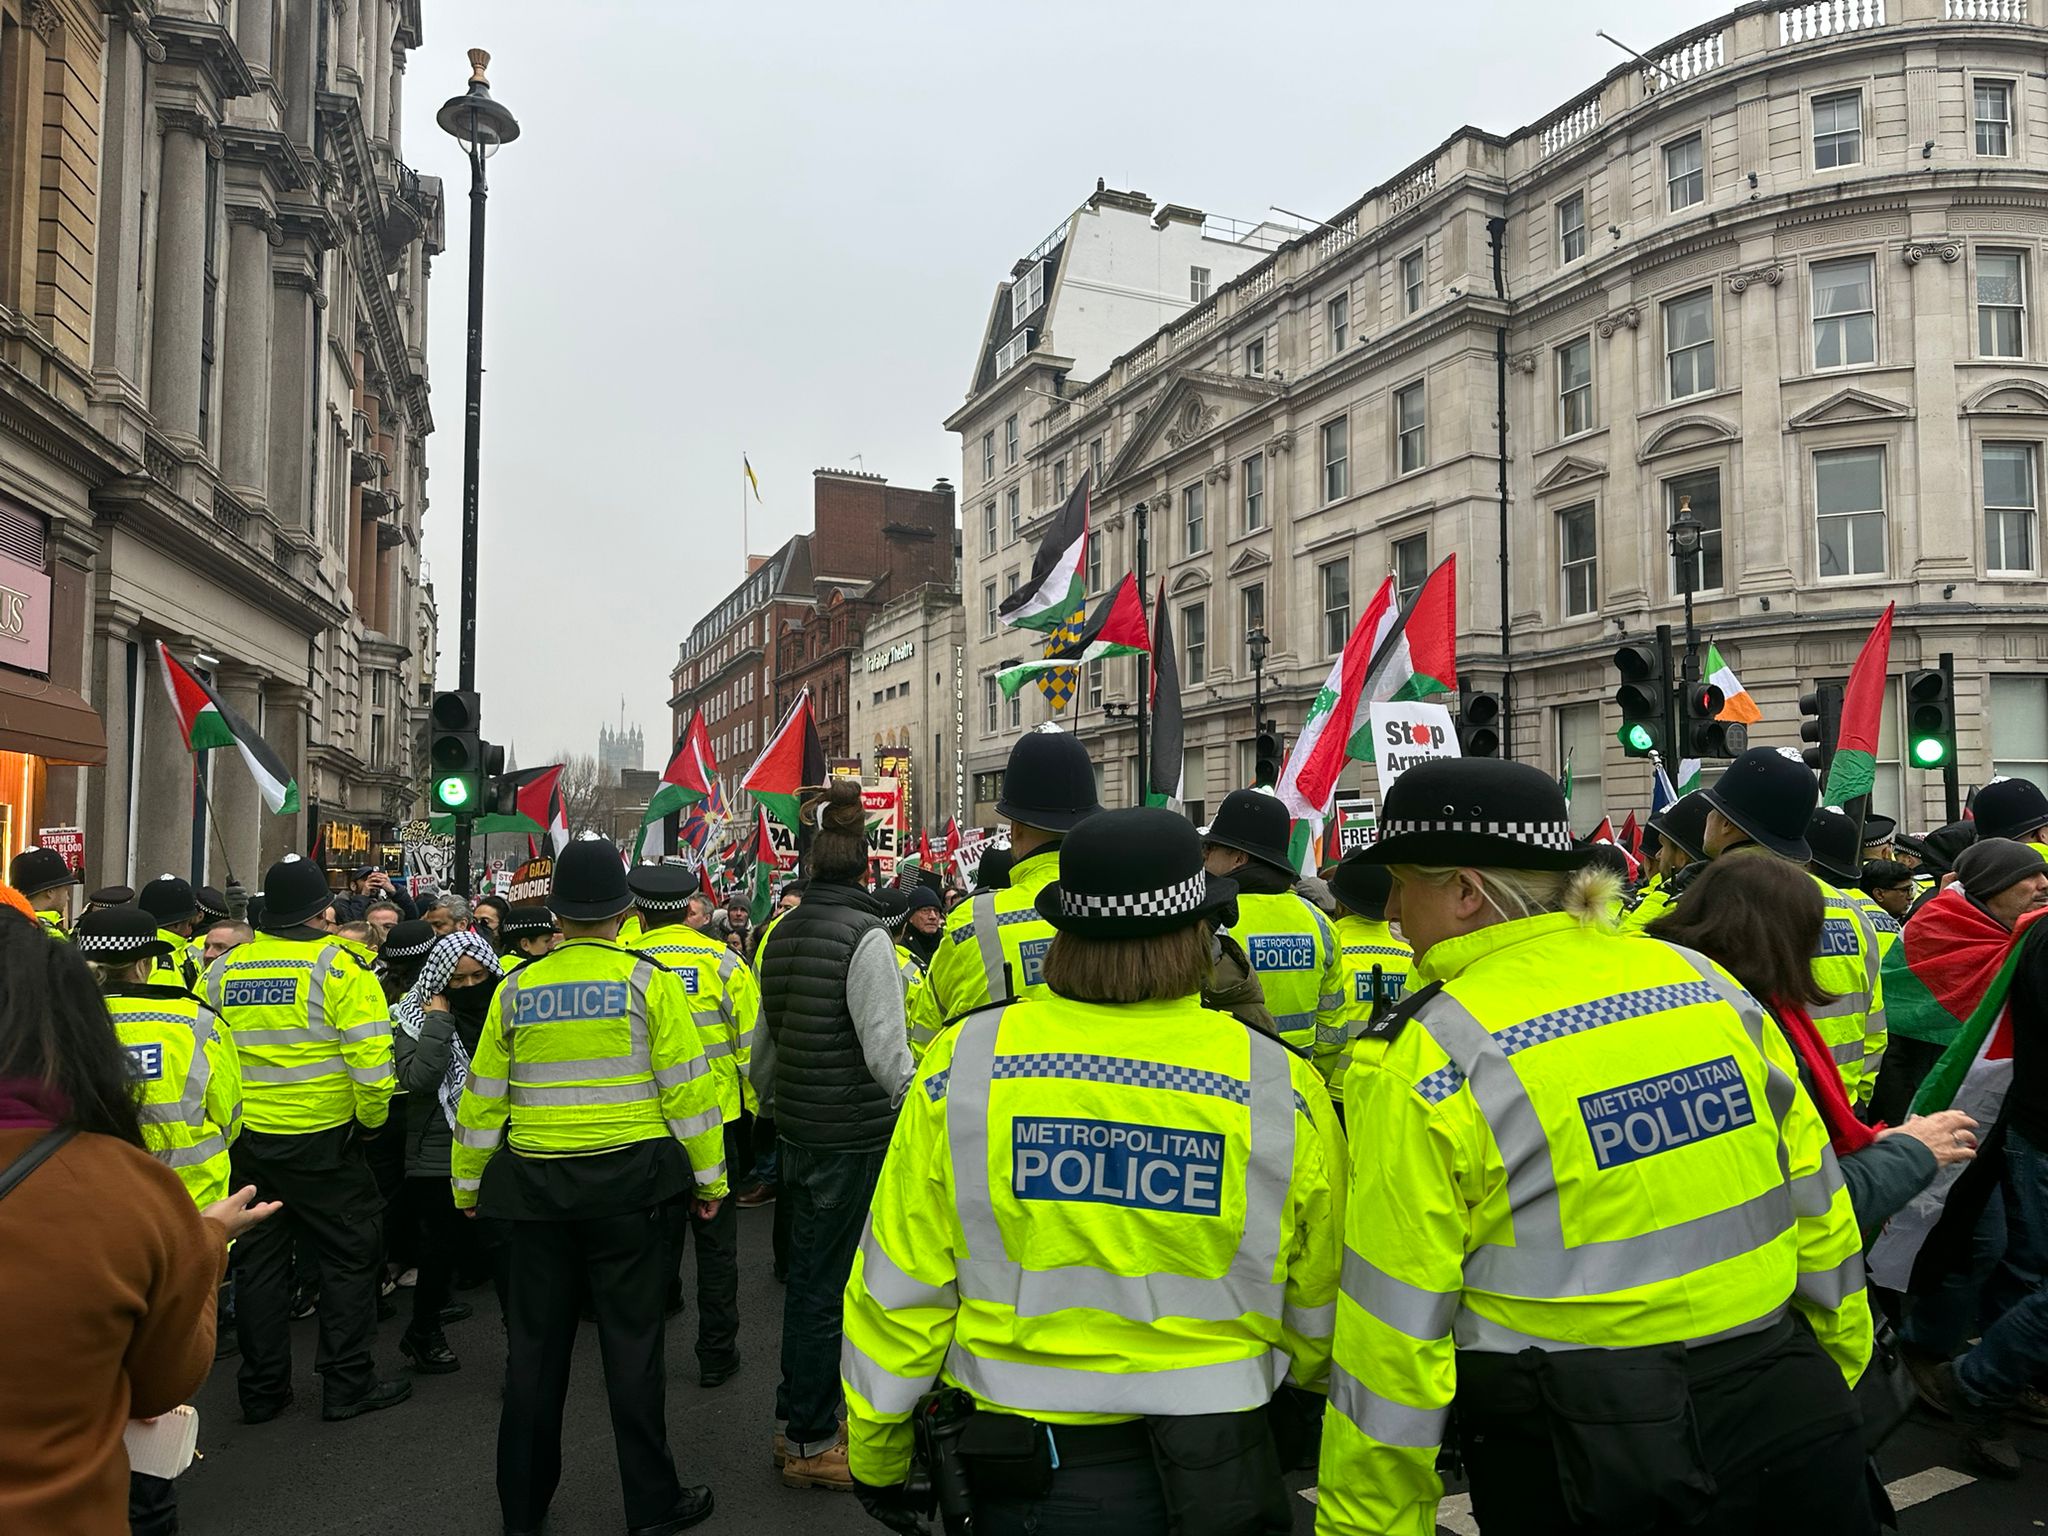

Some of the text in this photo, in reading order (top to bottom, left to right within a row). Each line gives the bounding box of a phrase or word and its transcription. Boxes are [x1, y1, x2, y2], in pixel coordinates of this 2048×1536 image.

[866, 641, 913, 672] Trafalgar Theatre
[956, 646, 964, 828] Trafalgar Theatre
[1385, 721, 1445, 749] Stop
[861, 795, 888, 808] Party
[42, 835, 76, 845] STARMER
[58, 843, 82, 852] BLOOD
[1341, 828, 1376, 845] FREE
[529, 860, 551, 878] GAZA
[508, 877, 551, 902] GENOCIDE
[1254, 938, 1312, 948] METROPOLITAN
[1255, 949, 1311, 968] POLICE
[227, 980, 296, 989] METROPOLITAN
[225, 988, 294, 1005] POLICE
[519, 985, 620, 1021] POLICE
[1583, 1060, 1740, 1121] METROPOLITAN
[1591, 1083, 1753, 1165] POLICE
[1016, 1122, 1220, 1161] METROPOLITAN
[1015, 1149, 1218, 1209] POLICE
